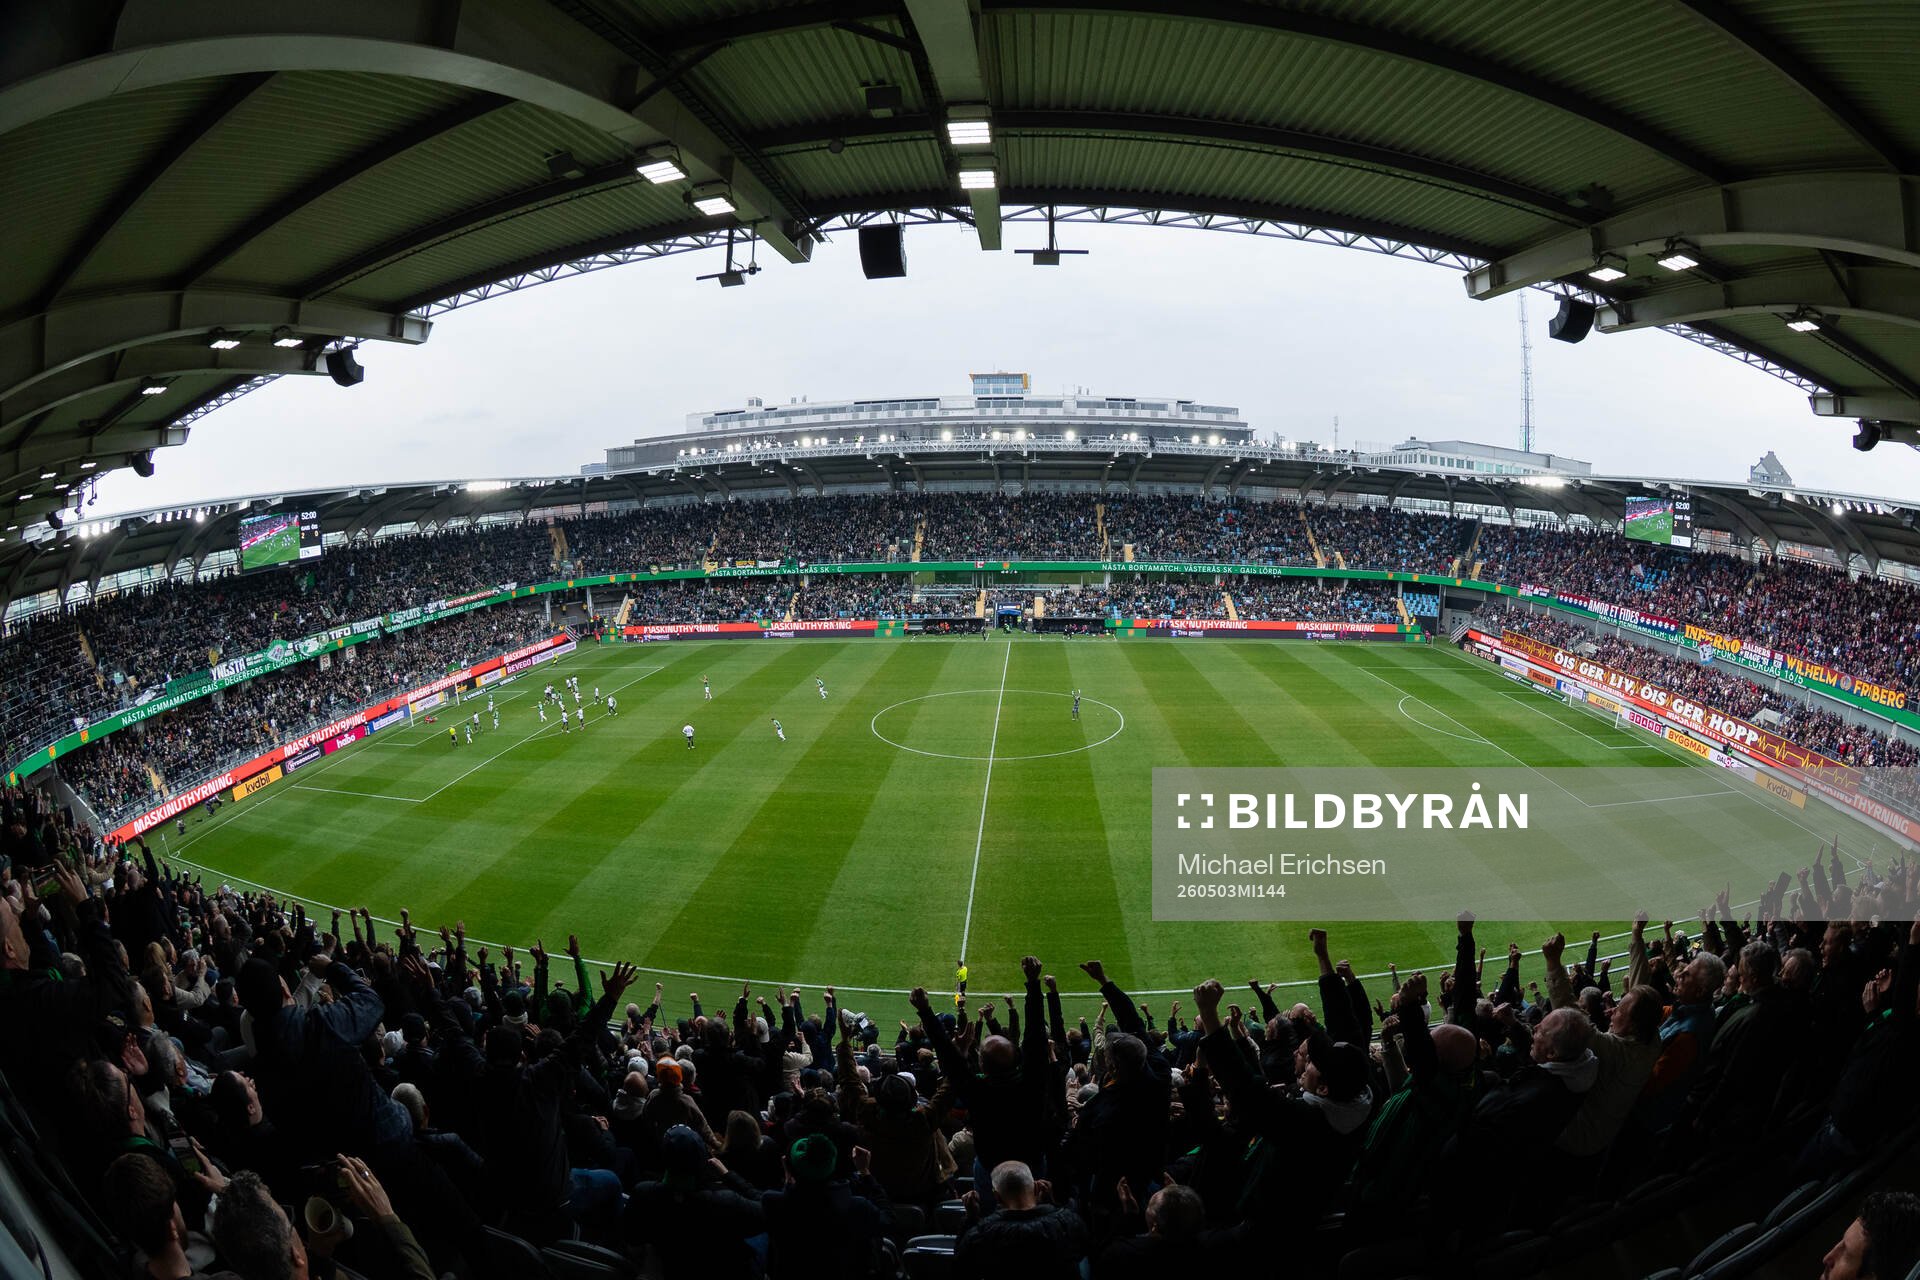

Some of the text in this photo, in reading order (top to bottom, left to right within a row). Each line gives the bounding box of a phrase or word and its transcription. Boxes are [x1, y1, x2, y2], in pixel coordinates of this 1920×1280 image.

[301, 511, 317, 520] 52:00
[1675, 502, 1690, 510] 52:00
[1102, 563, 1126, 571] NÄSTA
[1183, 564, 1220, 573] VÄSTERÅS
[1588, 600, 1640, 624] AMOR ET FIDES
[329, 627, 351, 640] TIFO
[766, 621, 852, 631] ASKINUTHYRNING
[1159, 620, 1248, 629] ASKNUTHYRNING
[506, 658, 532, 674] BEVEGO
[1471, 647, 1496, 662] XL-BYGG
[1668, 634, 1685, 645] GAIS
[1784, 670, 1804, 684] 16/5
[1786, 654, 1838, 687] WILHELM
[1853, 680, 1906, 709] FRIBERG
[121, 709, 146, 726] NÄSTA
[146, 689, 201, 716] HEMMAMATCH:
[201, 683, 219, 694] GAIS
[224, 665, 264, 687] DEGERFORS
[1554, 650, 1575, 671] ÖIS
[1579, 662, 1605, 682] GER
[1640, 683, 1667, 706] ÖIS
[1672, 698, 1705, 724] GER
[1708, 713, 1759, 746] HOPP
[284, 711, 367, 757] MASKNUTHYRNING
[1668, 730, 1708, 756] BYGGMAX
[245, 772, 271, 794] kvdbil
[1766, 777, 1793, 801] kvdbil
[133, 773, 233, 835] MASKINUTHYRNING
